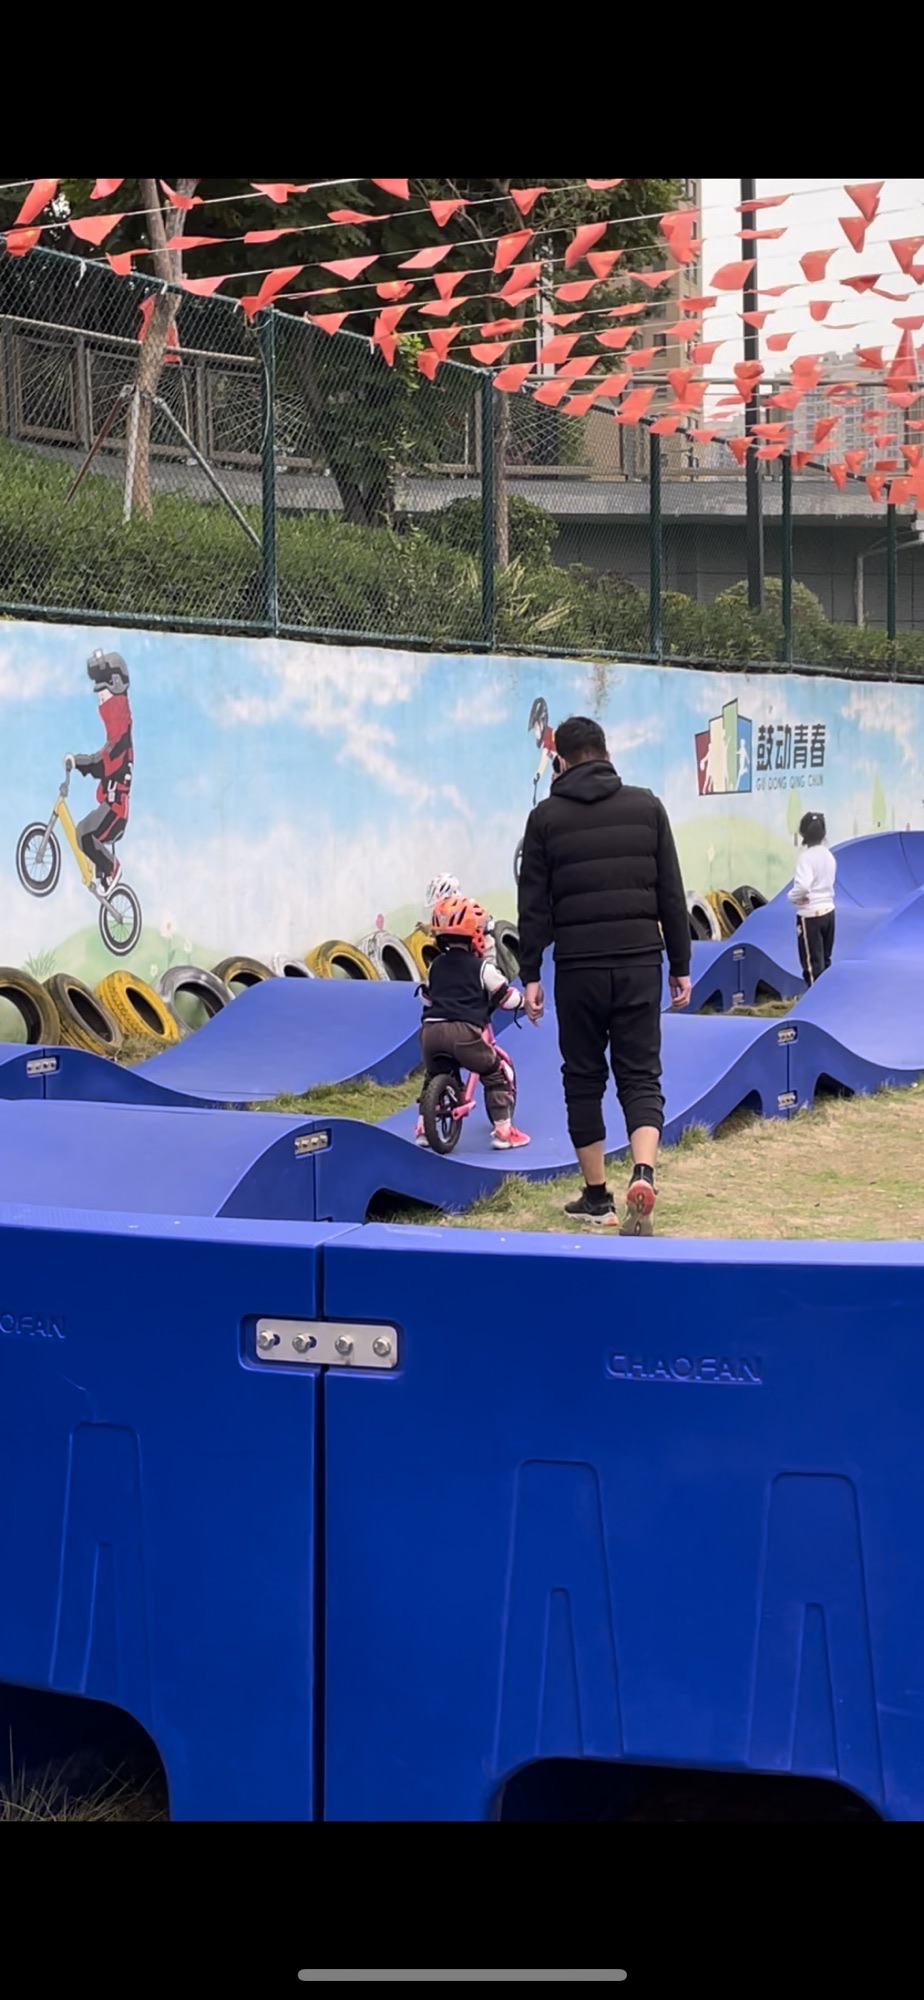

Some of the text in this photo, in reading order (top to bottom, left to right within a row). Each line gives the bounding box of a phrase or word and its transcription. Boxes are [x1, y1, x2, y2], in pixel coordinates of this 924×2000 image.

[756, 724, 826, 771] 鼓动青春
[768, 777, 787, 790] DONG
[789, 775, 805, 789] QING
[808, 774, 824, 787] CHUN
[606, 1353, 762, 1383] CHAOFAN
